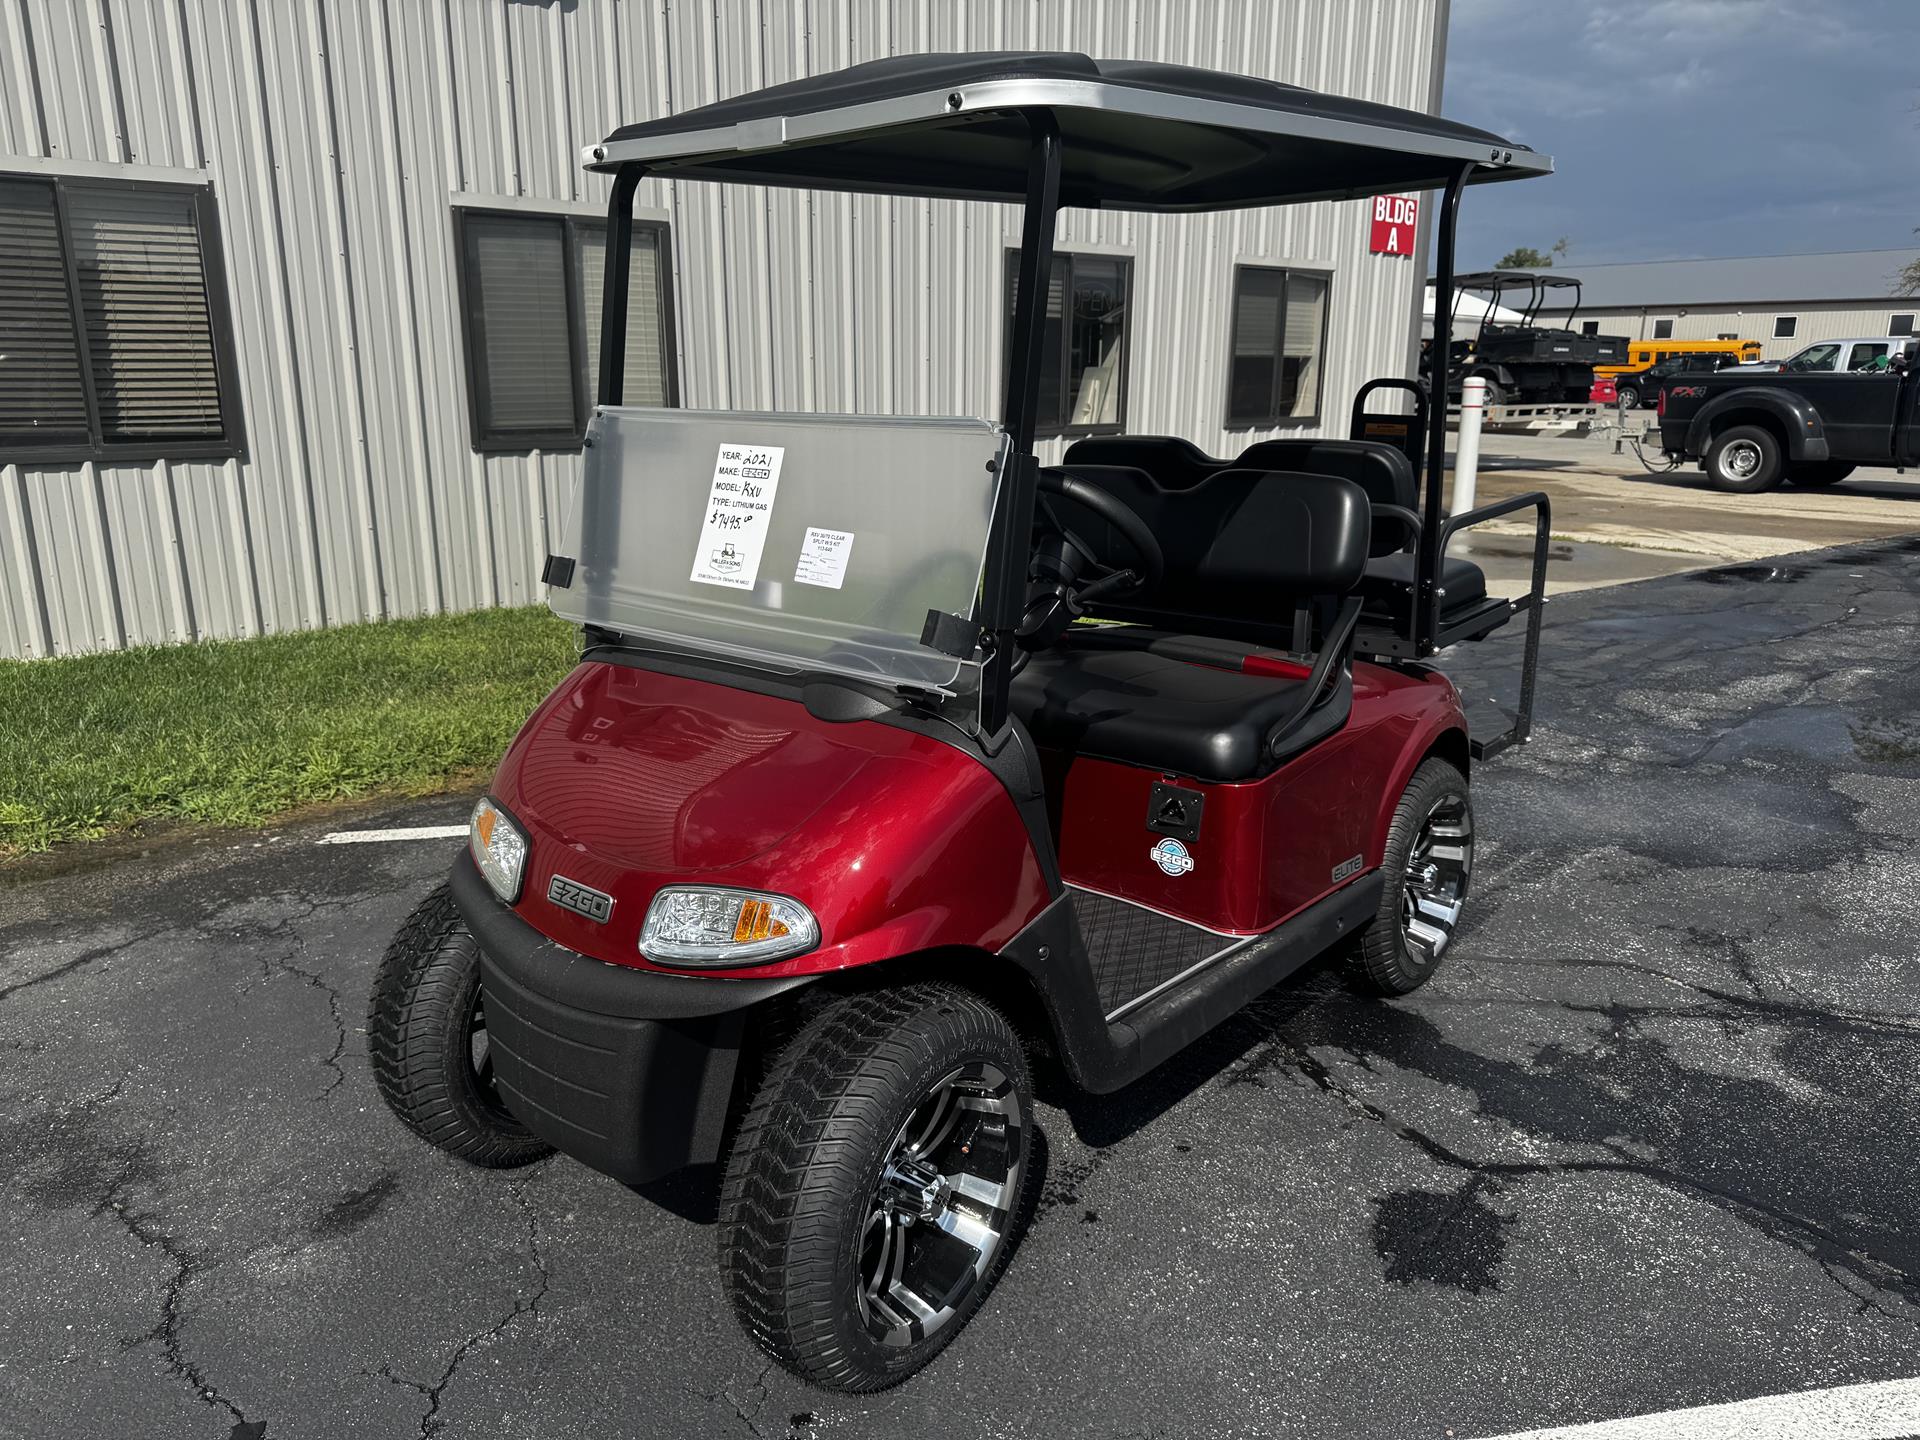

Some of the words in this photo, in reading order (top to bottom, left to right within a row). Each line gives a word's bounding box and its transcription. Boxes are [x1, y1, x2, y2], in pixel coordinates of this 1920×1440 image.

[1375, 196, 1415, 226] BLDG
[1387, 227, 1398, 252] A
[722, 451, 742, 460] YEAR:
[742, 450, 772, 467] 2021
[718, 467, 740, 476] MAKE:
[715, 482, 741, 492] MODEL:
[712, 497, 732, 507] TYPE:
[732, 501, 755, 510] LITHIUM
[755, 503, 768, 511] GAS
[1152, 848, 1192, 869] EZGO
[1334, 856, 1361, 880] ELITE
[549, 879, 609, 920] EZGO
